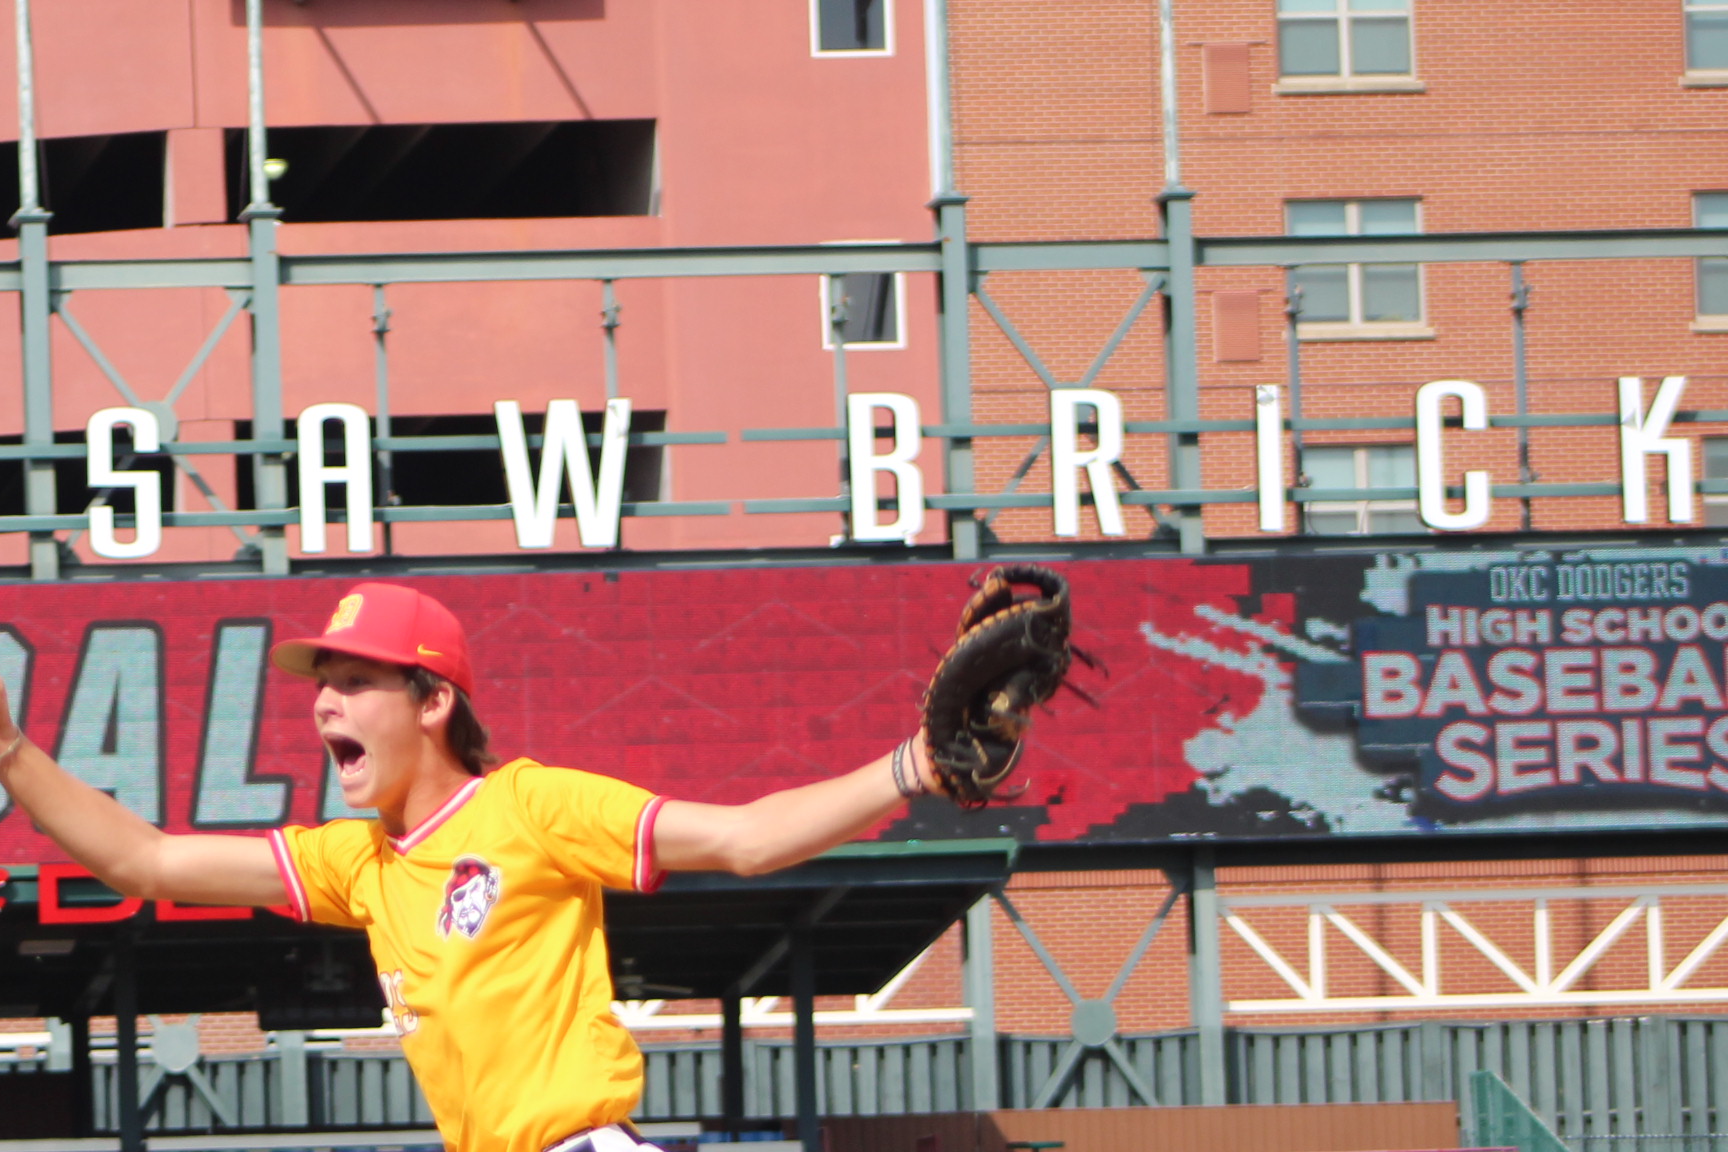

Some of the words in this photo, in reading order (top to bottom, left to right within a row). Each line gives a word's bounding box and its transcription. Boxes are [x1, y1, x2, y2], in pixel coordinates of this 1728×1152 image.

[847, 375, 1693, 544] BRICK
[1489, 564, 1550, 600] OKC
[1556, 560, 1691, 600] DODGERS
[1426, 604, 1553, 647] HIGH
[1362, 643, 1728, 718] BASEBA
